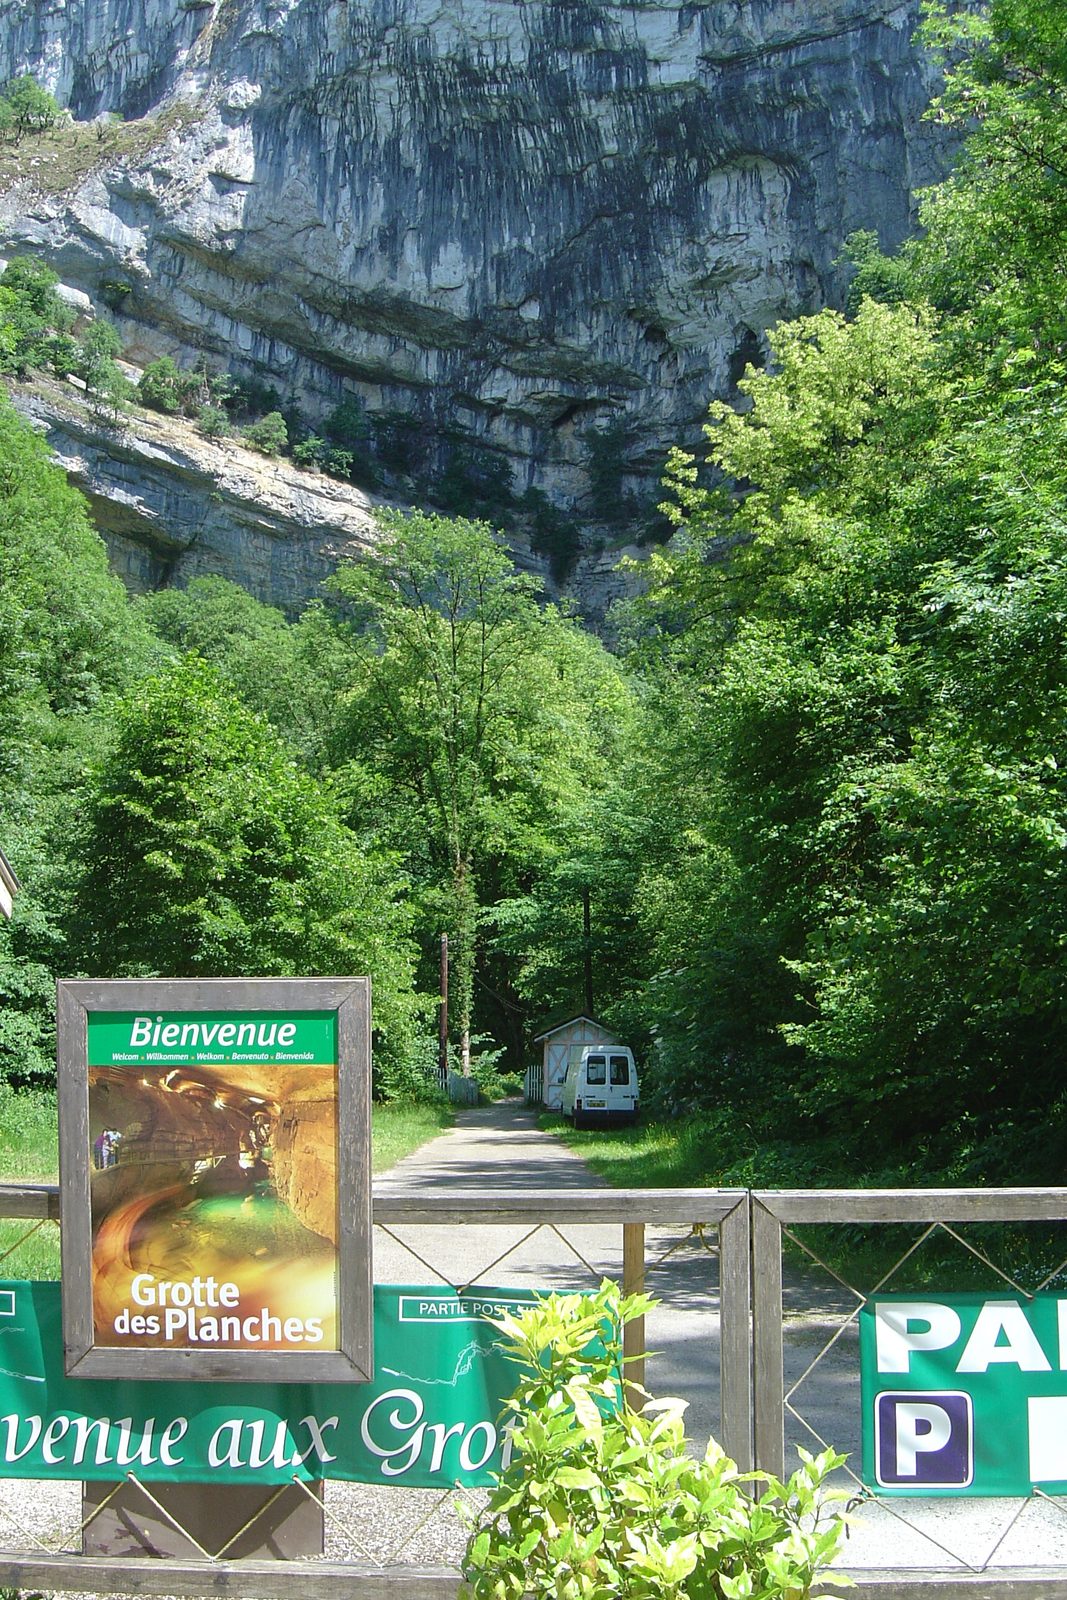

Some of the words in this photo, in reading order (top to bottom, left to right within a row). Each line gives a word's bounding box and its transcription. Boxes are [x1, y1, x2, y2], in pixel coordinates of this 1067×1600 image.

[129, 1015, 297, 1047] Bienvenue
[146, 1052, 189, 1061] Willkommen
[196, 1052, 225, 1061] Welkom
[231, 1052, 270, 1061] Benvenuto
[275, 1052, 315, 1061] Bienvenida
[131, 1274, 240, 1308] Grotte
[419, 1302, 469, 1315] PARTIE
[114, 1310, 161, 1335] des
[164, 1307, 324, 1343] Planches
[875, 1299, 1067, 1373] PA
[208, 1415, 339, 1470] aux
[895, 1402, 952, 1477] P
